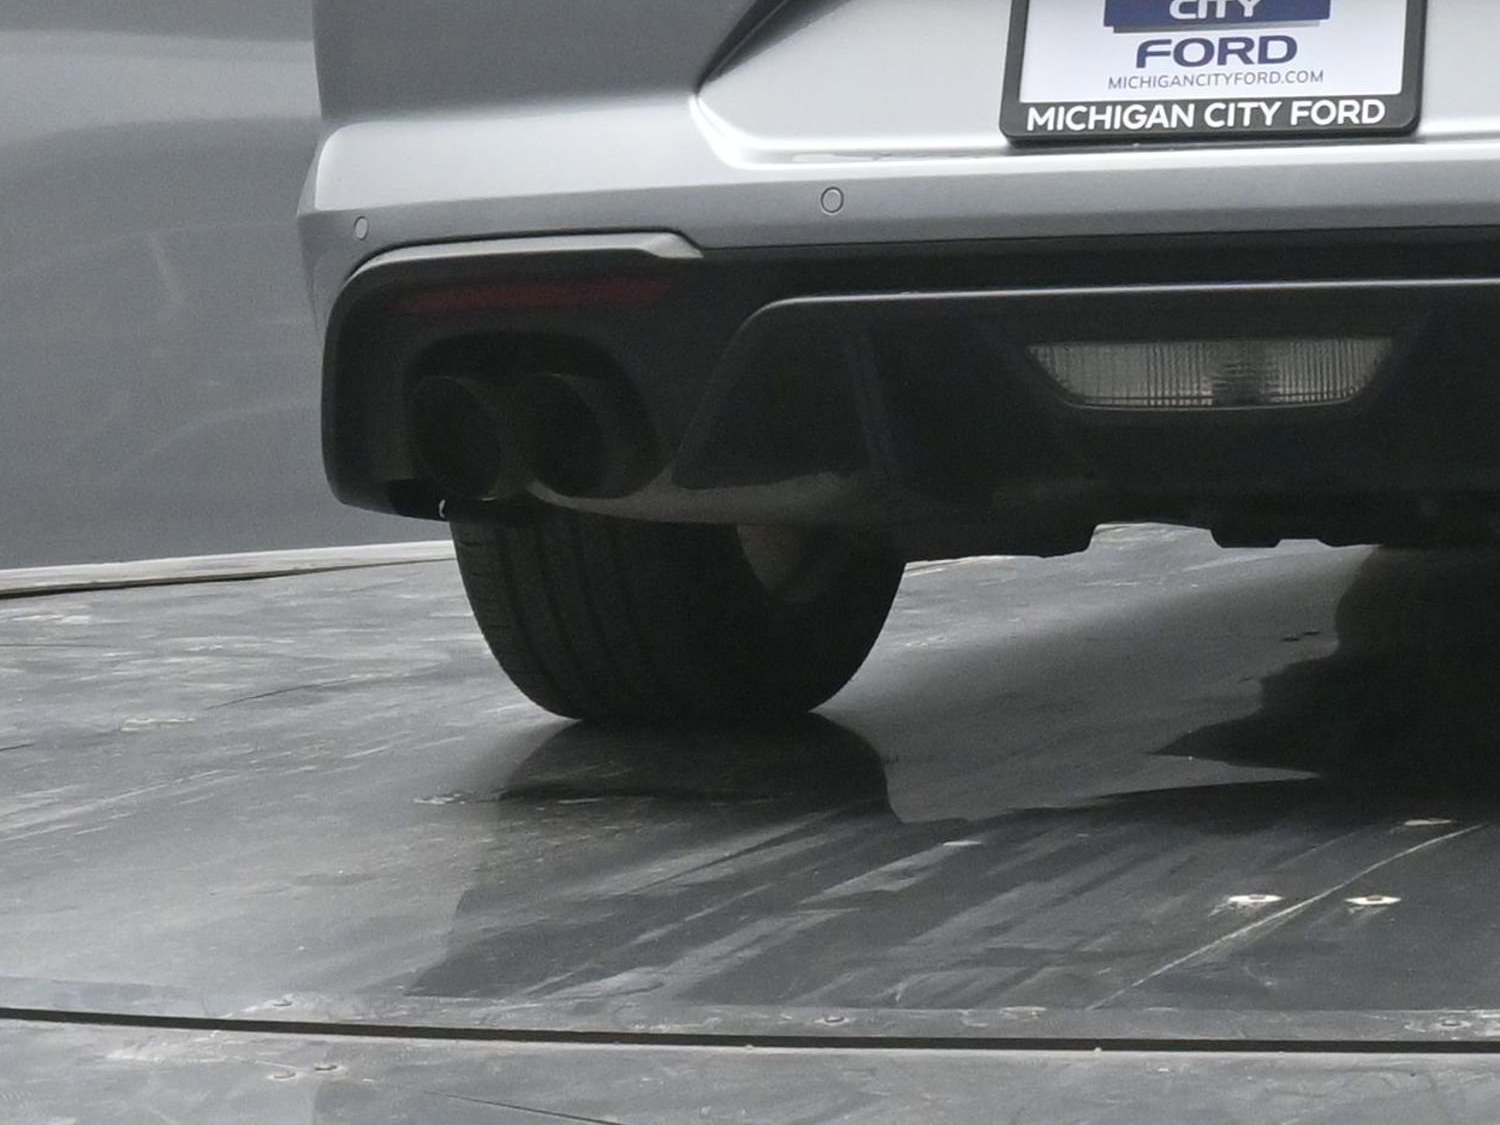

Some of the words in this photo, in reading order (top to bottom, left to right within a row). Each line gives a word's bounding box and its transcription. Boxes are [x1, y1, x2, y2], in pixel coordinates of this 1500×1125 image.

[1135, 35, 1298, 68] FORD
[1108, 69, 1324, 91] MICHIGANCITYFORD.COM
[1026, 103, 1196, 133] MICHIGAN
[1204, 101, 1282, 129] CITY
[1290, 99, 1386, 126] FORD
